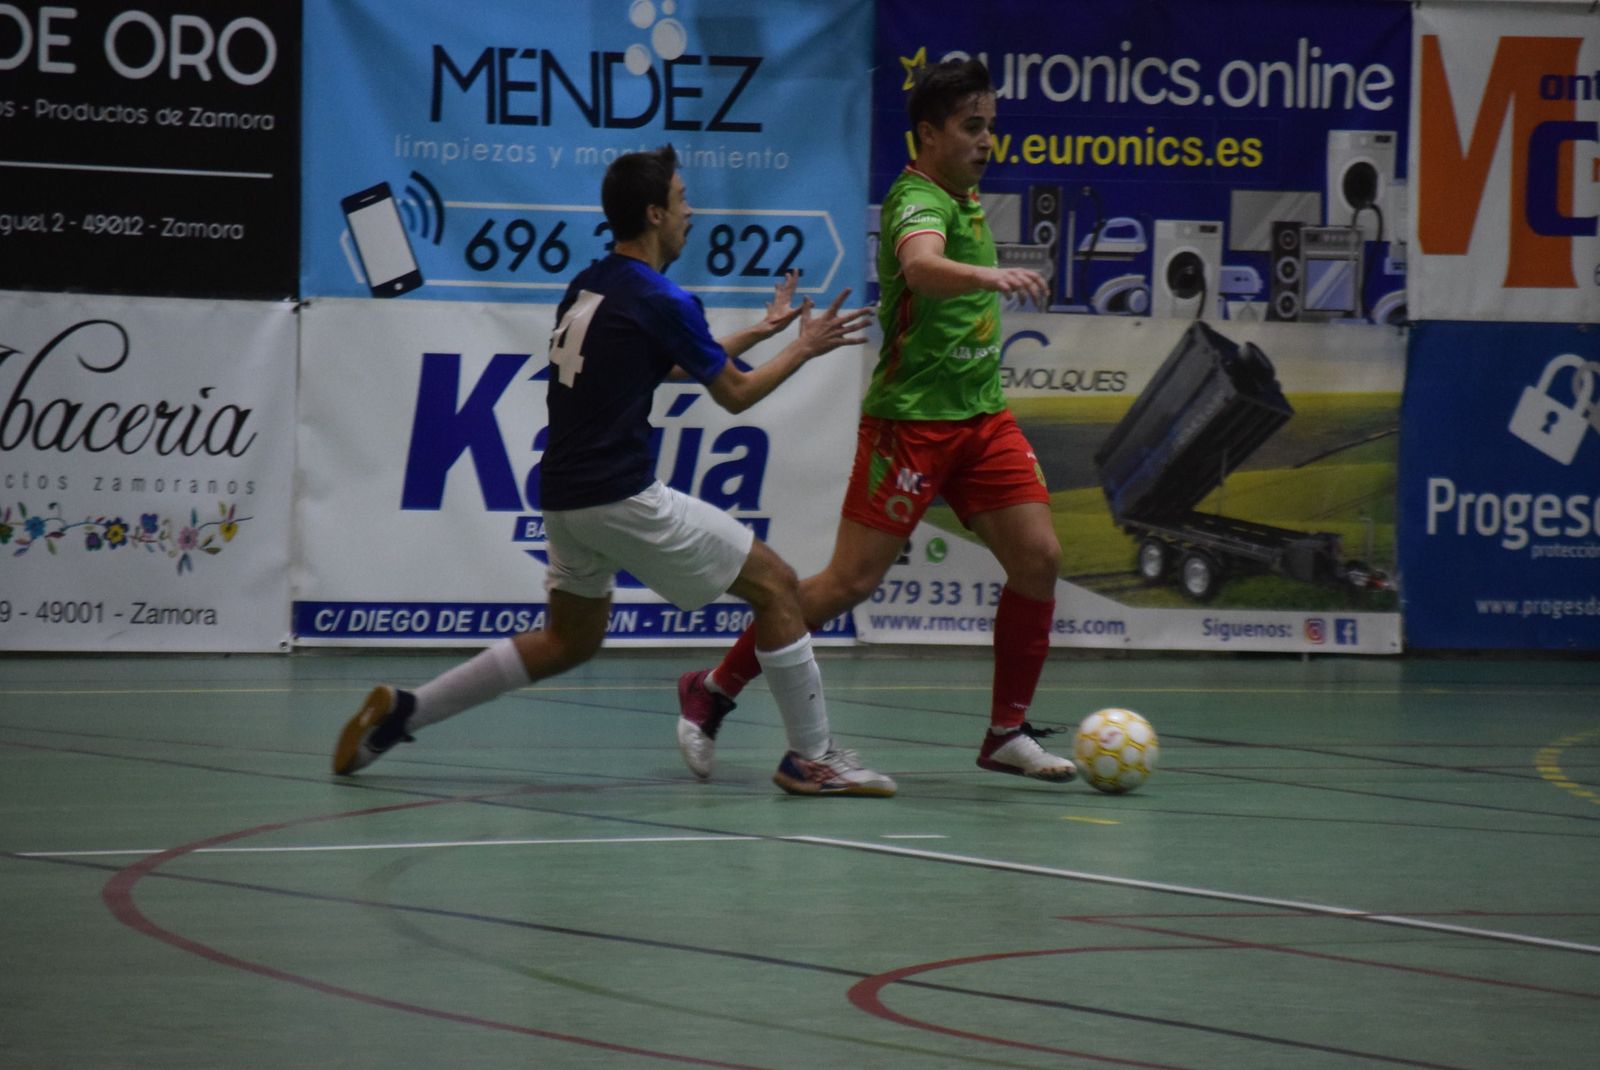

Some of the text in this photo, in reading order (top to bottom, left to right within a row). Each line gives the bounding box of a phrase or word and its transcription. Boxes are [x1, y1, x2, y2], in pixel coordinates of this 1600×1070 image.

[104, 10, 277, 86] ORO
[35, 98, 148, 125] Productos
[155, 107, 183, 126] de
[188, 107, 275, 130] Zamora
[394, 134, 537, 165] limpiezas
[550, 143, 564, 167] y
[52, 212, 65, 233] 2
[82, 213, 144, 236] 49012
[161, 217, 244, 240] Zamora
[464, 218, 571, 274] 696
[706, 223, 805, 278] 822
[549, 289, 605, 389] 4
[999, 366, 1128, 393] EMOLQUES
[94, 475, 256, 496] zamoranos
[1426, 477, 1600, 551] Proges
[928, 580, 961, 606] 33
[35, 602, 104, 624] 49001
[129, 603, 217, 626] Zamora
[314, 609, 344, 632] C/
[347, 609, 430, 633] DIEGO
[436, 610, 474, 633] DE
